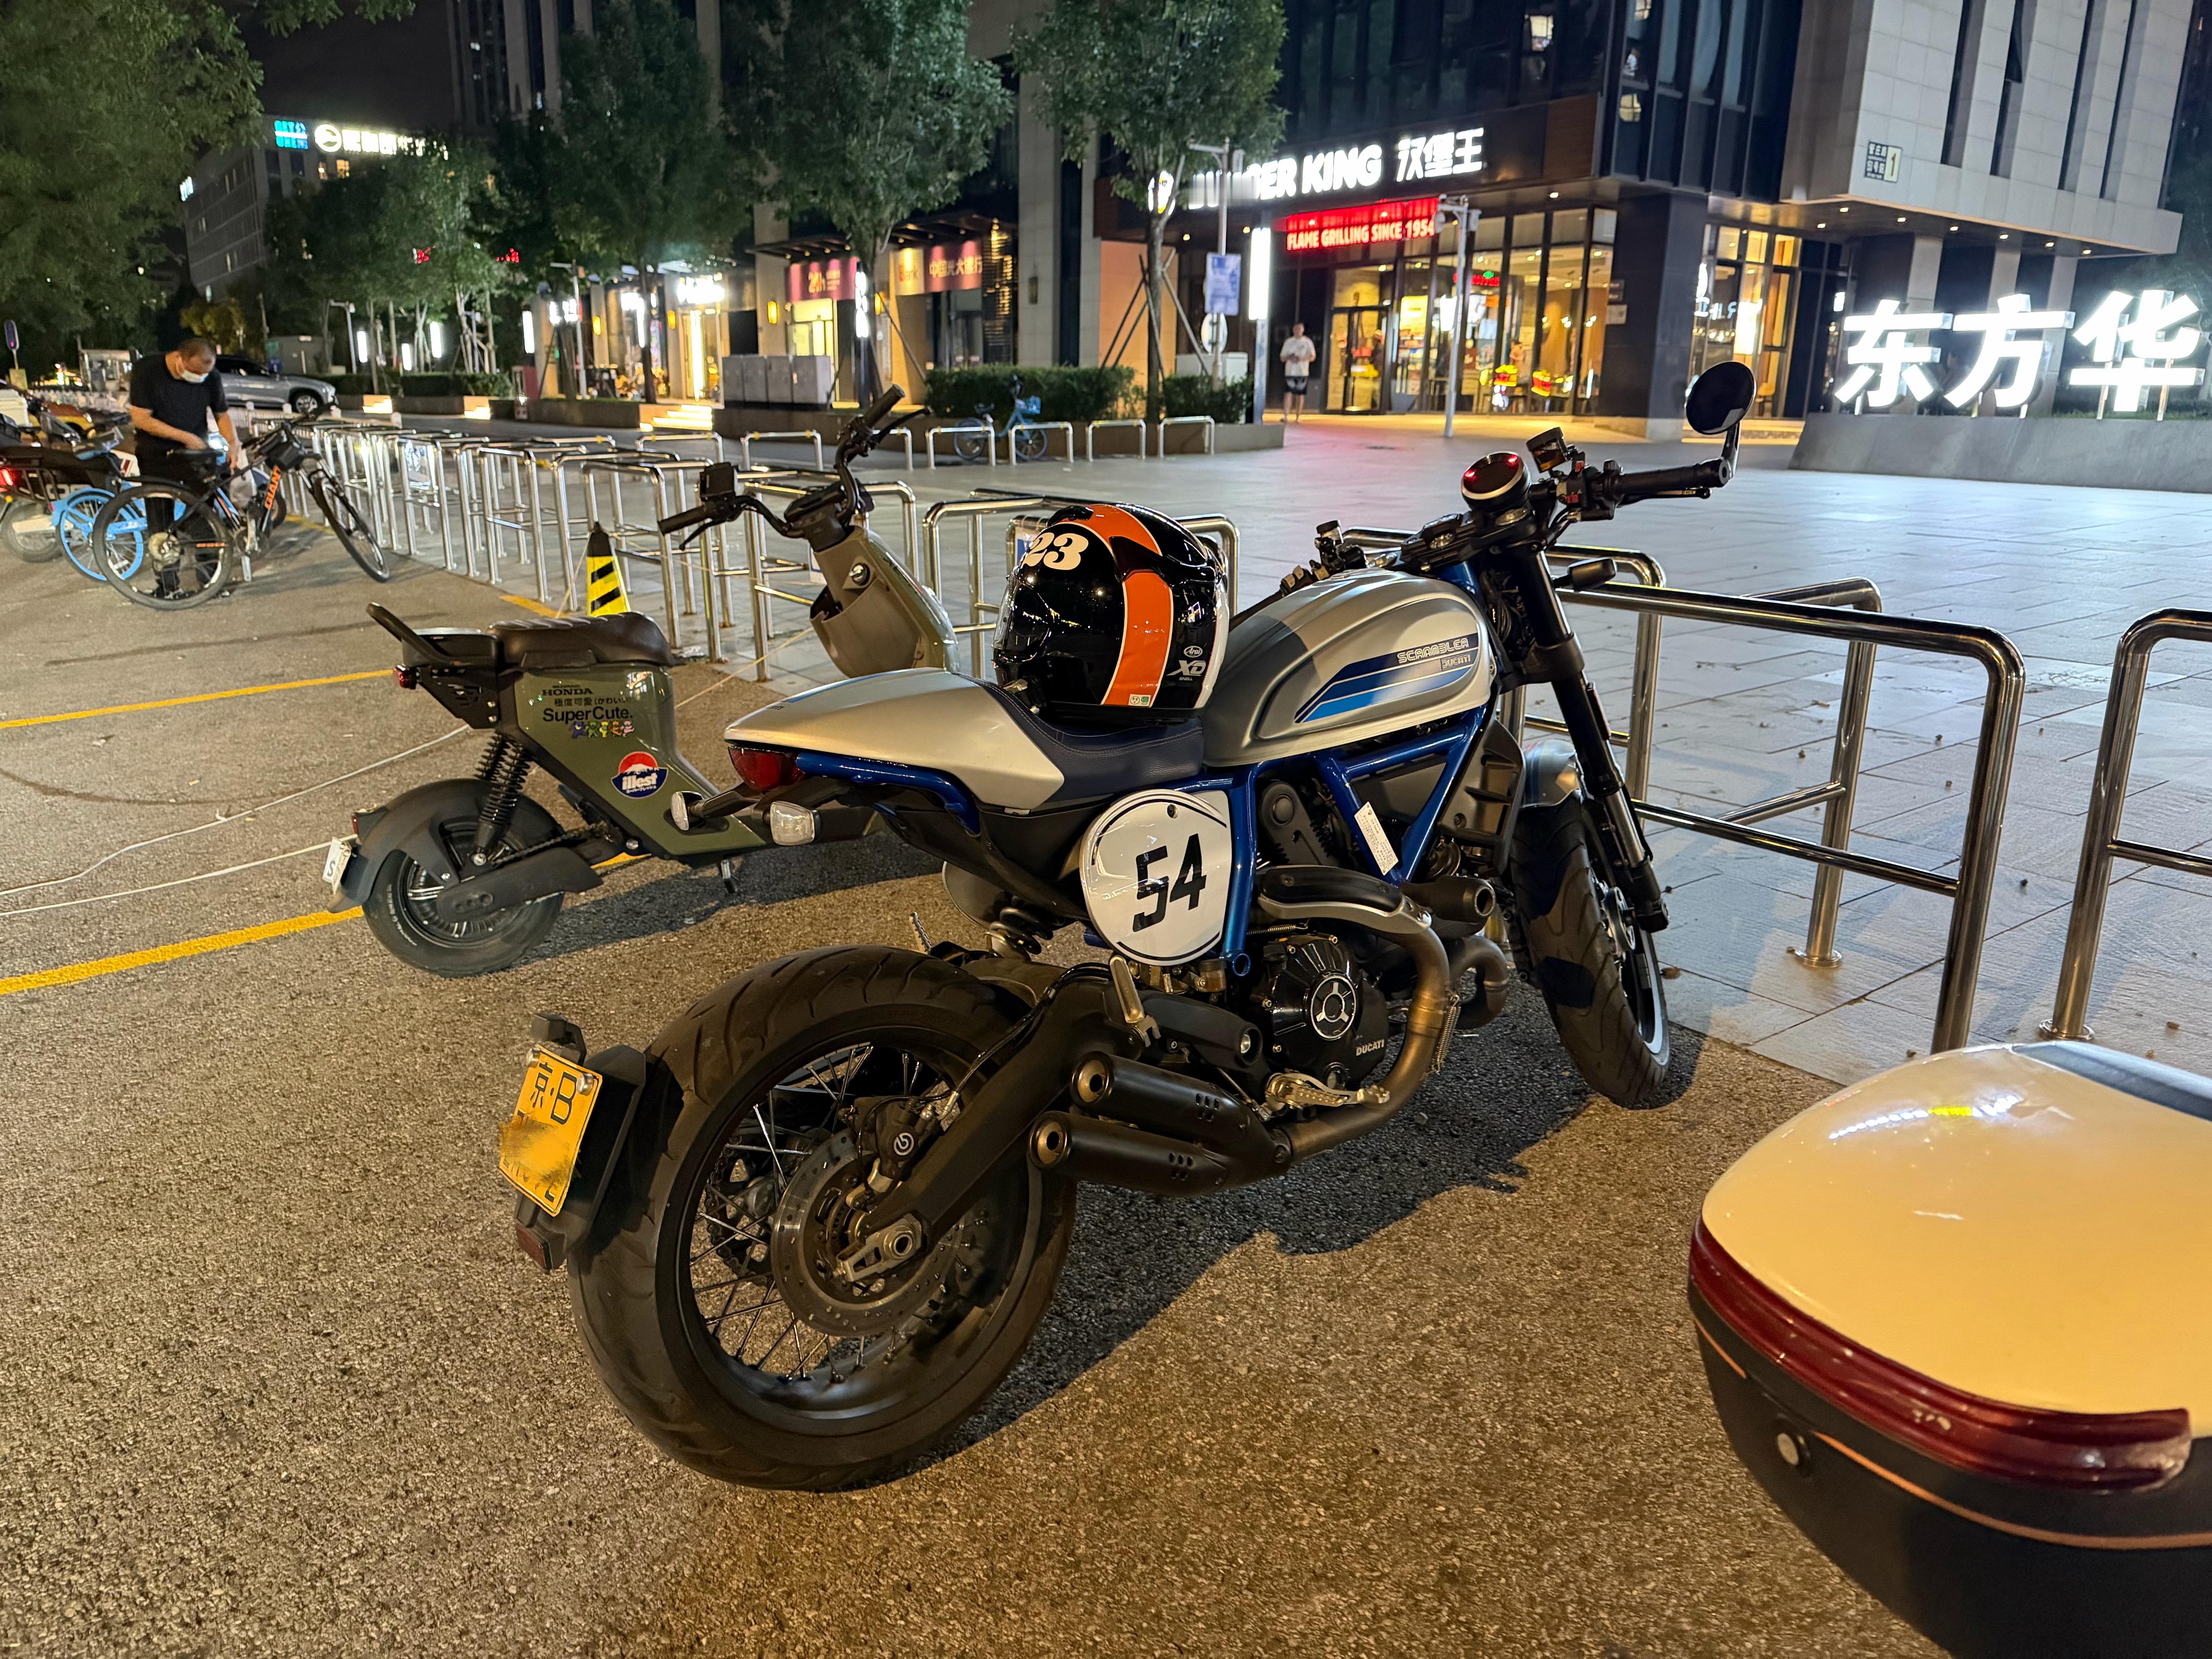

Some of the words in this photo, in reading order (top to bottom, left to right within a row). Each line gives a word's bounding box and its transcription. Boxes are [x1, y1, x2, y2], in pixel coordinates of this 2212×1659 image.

[1302, 144, 1382, 194] KING
[1396, 127, 1484, 182] 汉堡王
[1287, 230, 1319, 251] FLAME
[1321, 225, 1369, 247] GRILLING
[1371, 221, 1403, 243] SINCE
[1405, 218, 1435, 239] 1954
[1834, 290, 2205, 412] 东方华
[264, 465, 281, 509] GIANT
[1020, 532, 1089, 570] 23
[1397, 638, 1469, 663] SCRAMBLER
[1441, 654, 1471, 668] DUCATI
[622, 773, 658, 790] illest
[1132, 833, 1207, 932] 54
[1356, 1039, 1384, 1056] DUCATI
